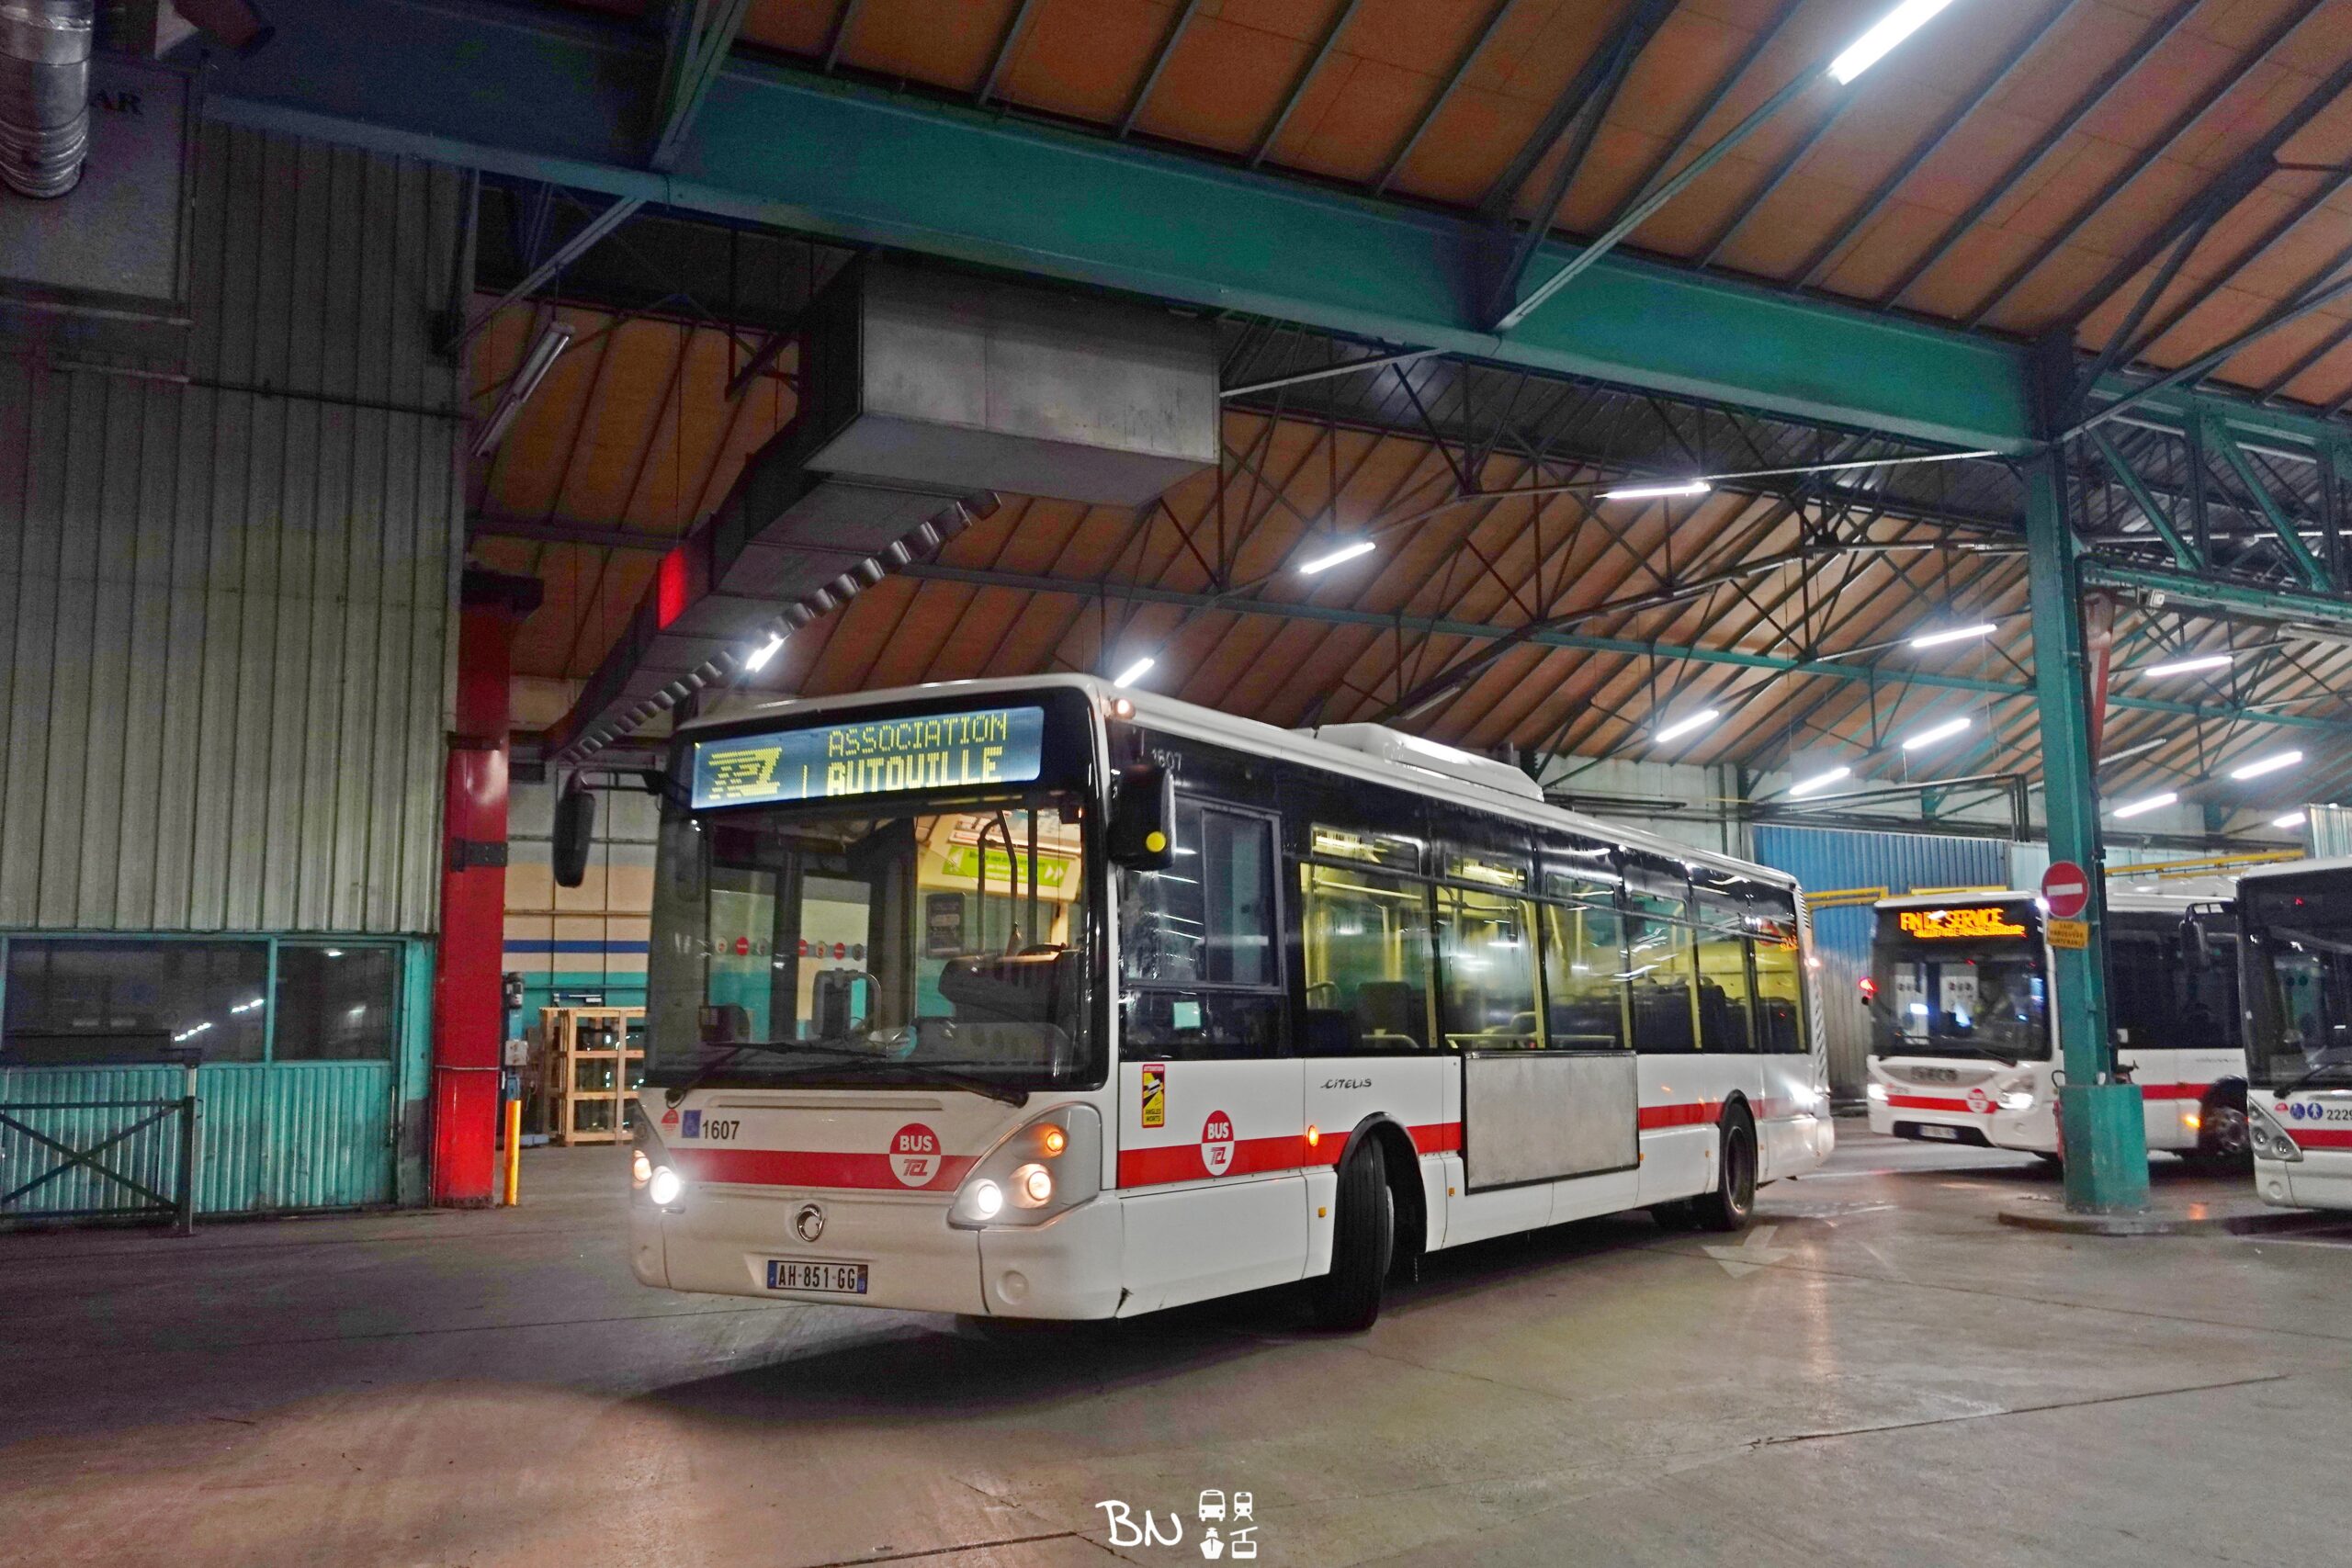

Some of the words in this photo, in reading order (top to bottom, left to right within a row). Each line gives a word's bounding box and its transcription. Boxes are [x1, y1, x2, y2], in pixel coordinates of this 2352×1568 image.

[829, 712, 1008, 757] ASSOCIATION
[827, 746, 1003, 796] AUTOVILLE
[1151, 749, 1182, 771] 1607
[702, 1119, 740, 1140] 1607
[1207, 1122, 1229, 1140] BUS
[899, 1134, 933, 1152] BUS
[778, 1264, 855, 1290] AH-851-GG
